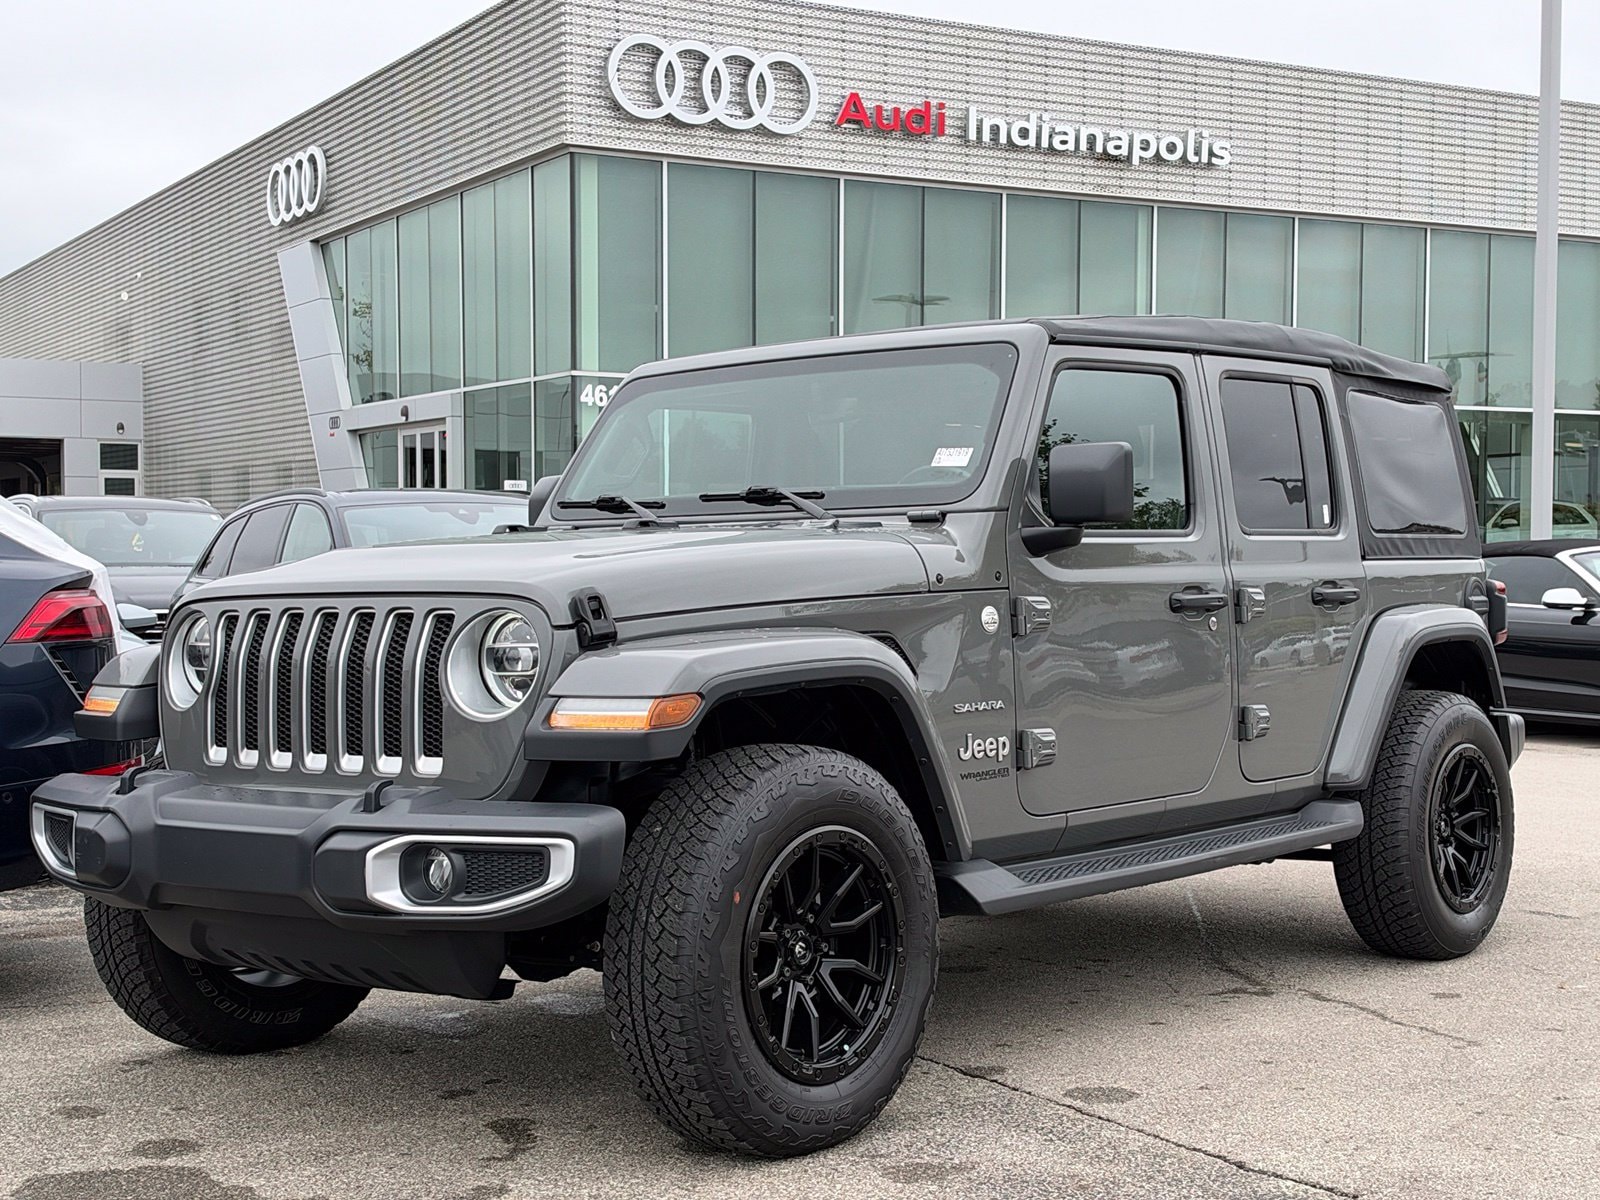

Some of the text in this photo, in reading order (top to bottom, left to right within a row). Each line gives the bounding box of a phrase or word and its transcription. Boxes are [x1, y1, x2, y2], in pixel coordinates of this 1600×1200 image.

[836, 92, 1232, 167] Audi Indianapolis
[954, 700, 1005, 713] SAHARA
[958, 733, 1010, 762] Jeep
[960, 767, 1010, 780] WRANGLER
[836, 787, 929, 902] DUELER
[720, 973, 852, 1124] BRIDGESTONE
